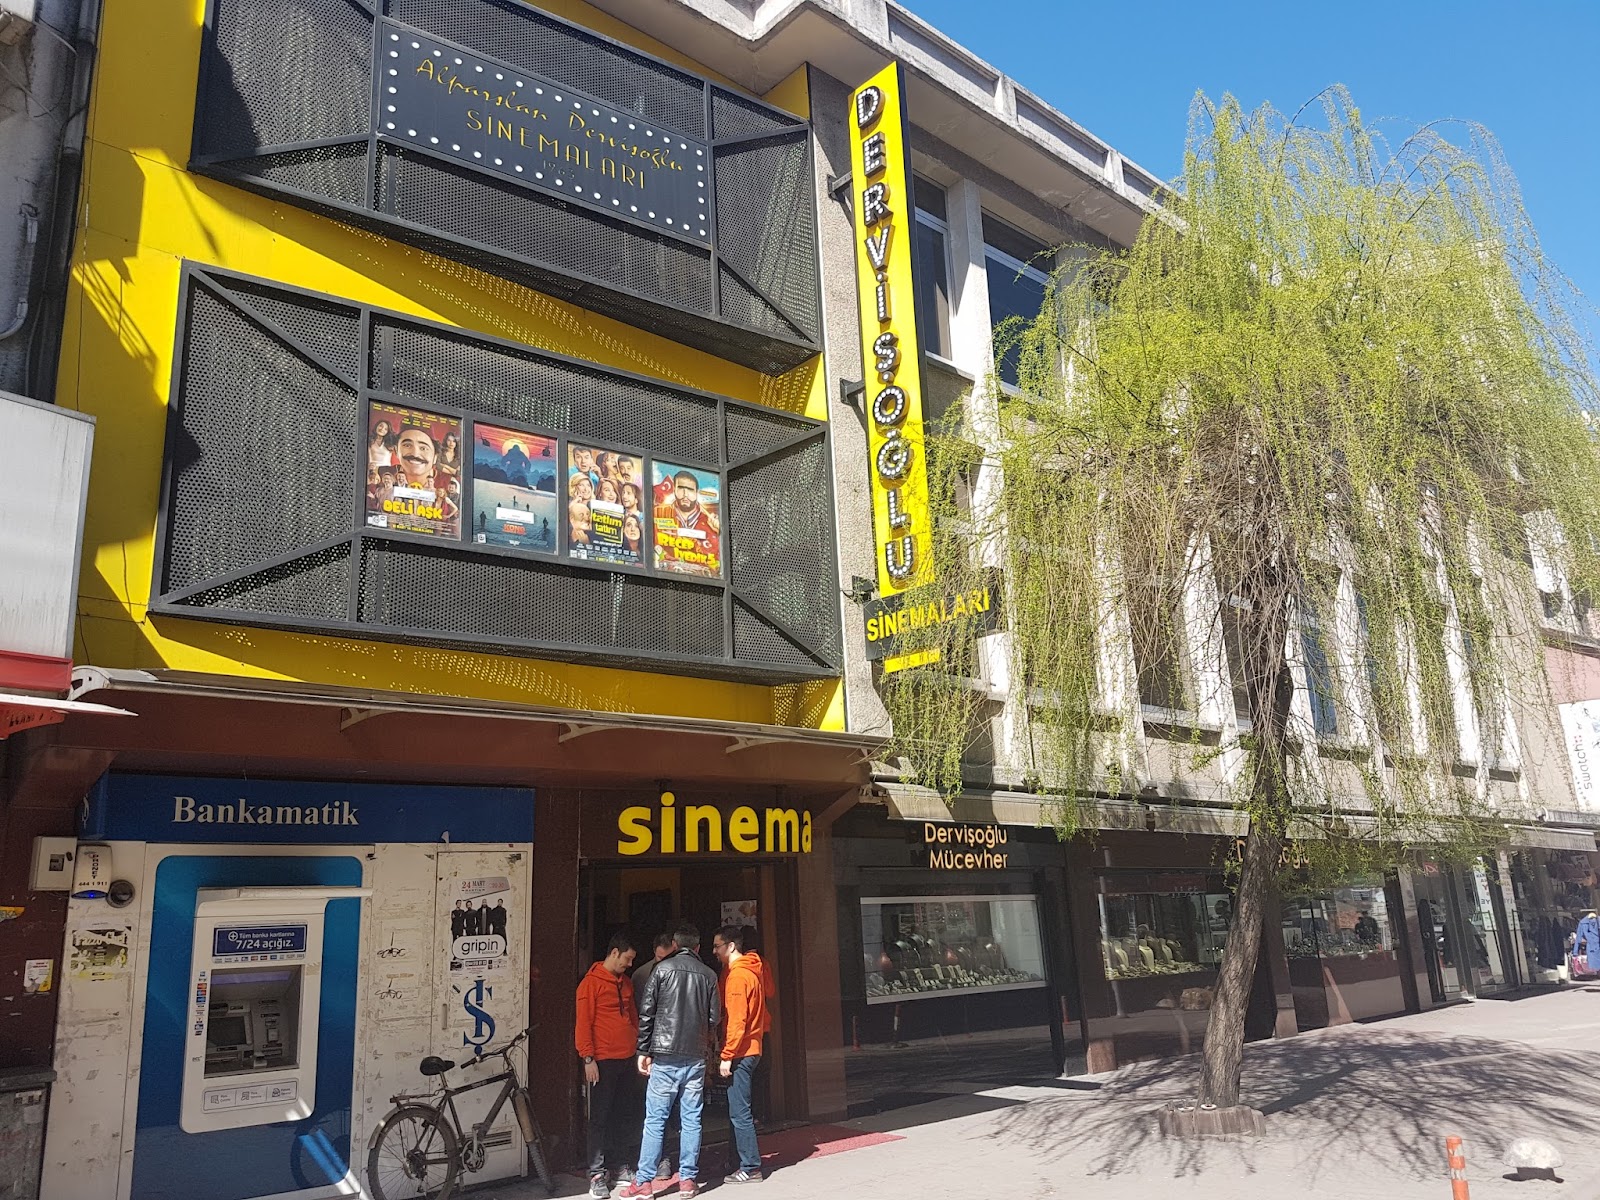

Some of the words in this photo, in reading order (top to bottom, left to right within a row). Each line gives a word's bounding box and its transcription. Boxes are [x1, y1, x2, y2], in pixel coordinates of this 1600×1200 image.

[415, 59, 548, 121] Alparslan
[172, 796, 360, 826] Bankamatik
[617, 791, 812, 856] sinema
[924, 822, 1008, 849] Dervişoğlu
[929, 849, 1008, 869] Mücevher
[235, 939, 261, 950] 7/24
[461, 939, 499, 955] gripin
